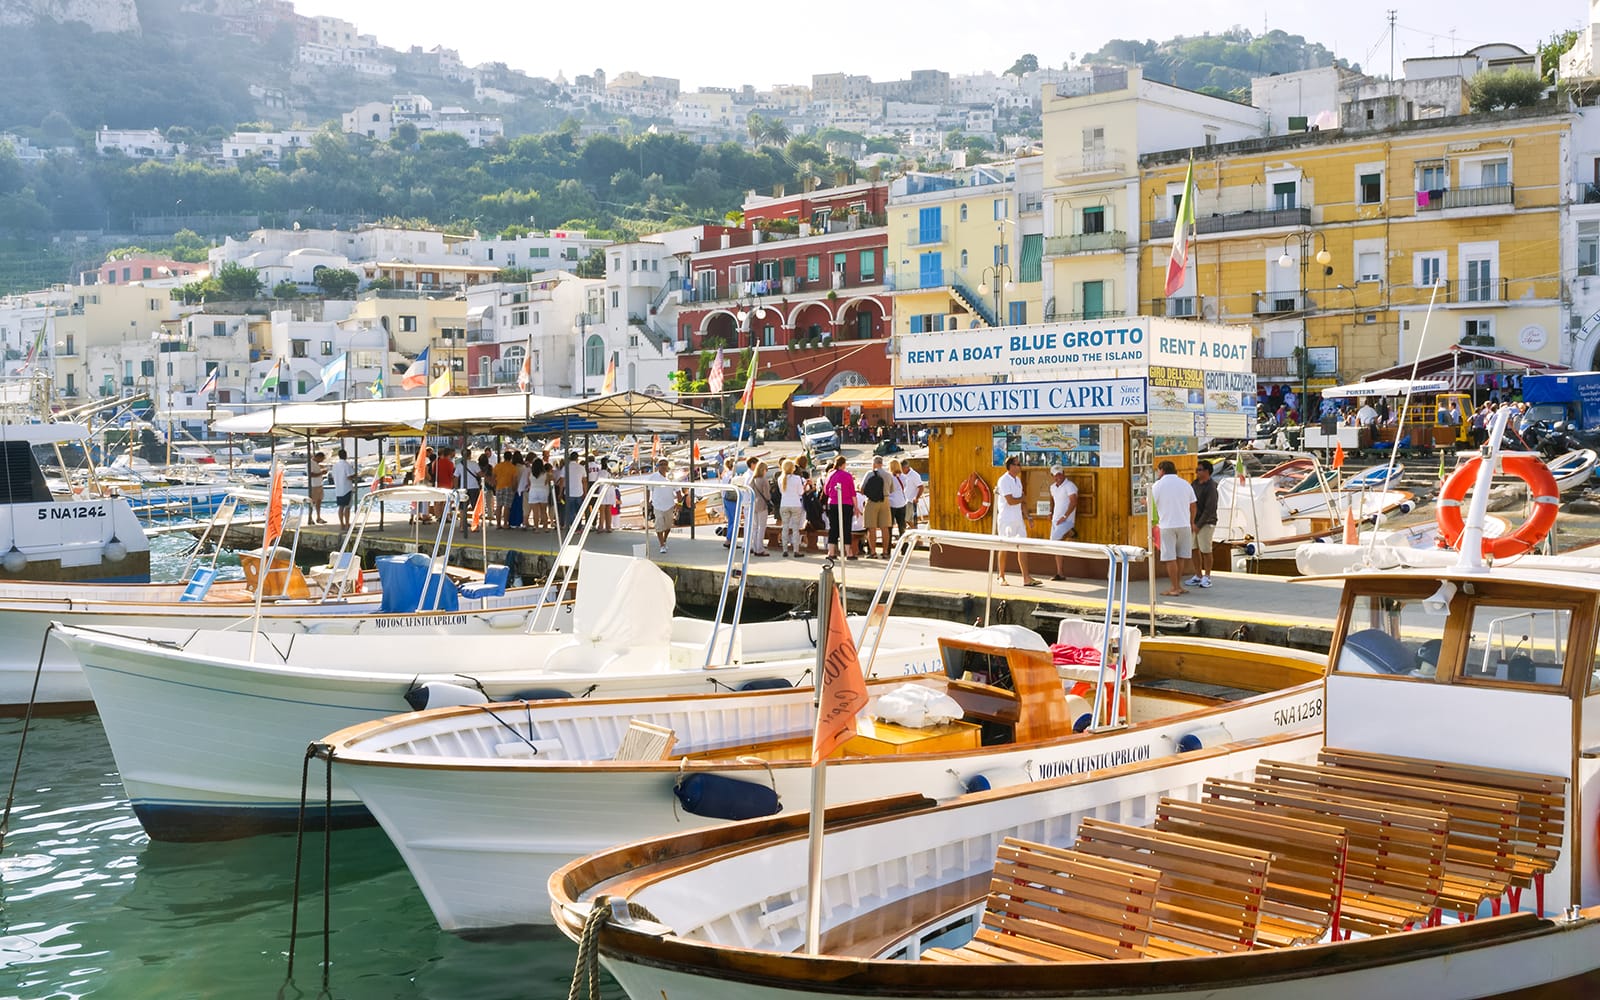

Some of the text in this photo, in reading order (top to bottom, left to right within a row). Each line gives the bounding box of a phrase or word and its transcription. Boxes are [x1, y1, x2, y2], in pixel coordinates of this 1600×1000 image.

[1010, 328, 1143, 351] BLUE GROTTO
[908, 346, 1003, 364] RENT A BOAT
[1160, 337, 1247, 360] RENT A BOAT
[1009, 350, 1142, 366] TOUR AROUND THE ISLAND
[1150, 366, 1203, 382] GIRO DELL'ISOLA
[1206, 372, 1256, 392] GROTTA AZZURRA
[1120, 385, 1140, 393] Since
[1155, 379, 1177, 387] GROTTA
[1179, 380, 1203, 388] AZZURRA
[899, 385, 1113, 413] MOTOSCAFISTI CAPRI
[1120, 396, 1140, 406] 1955
[51, 505, 106, 519] NA1242
[375, 615, 468, 628] MOTOSCAFISTICAPRI.COM
[1273, 698, 1323, 727] 5NA1258
[1039, 743, 1151, 780] MOTOSCAFISTICAPRI.COM
